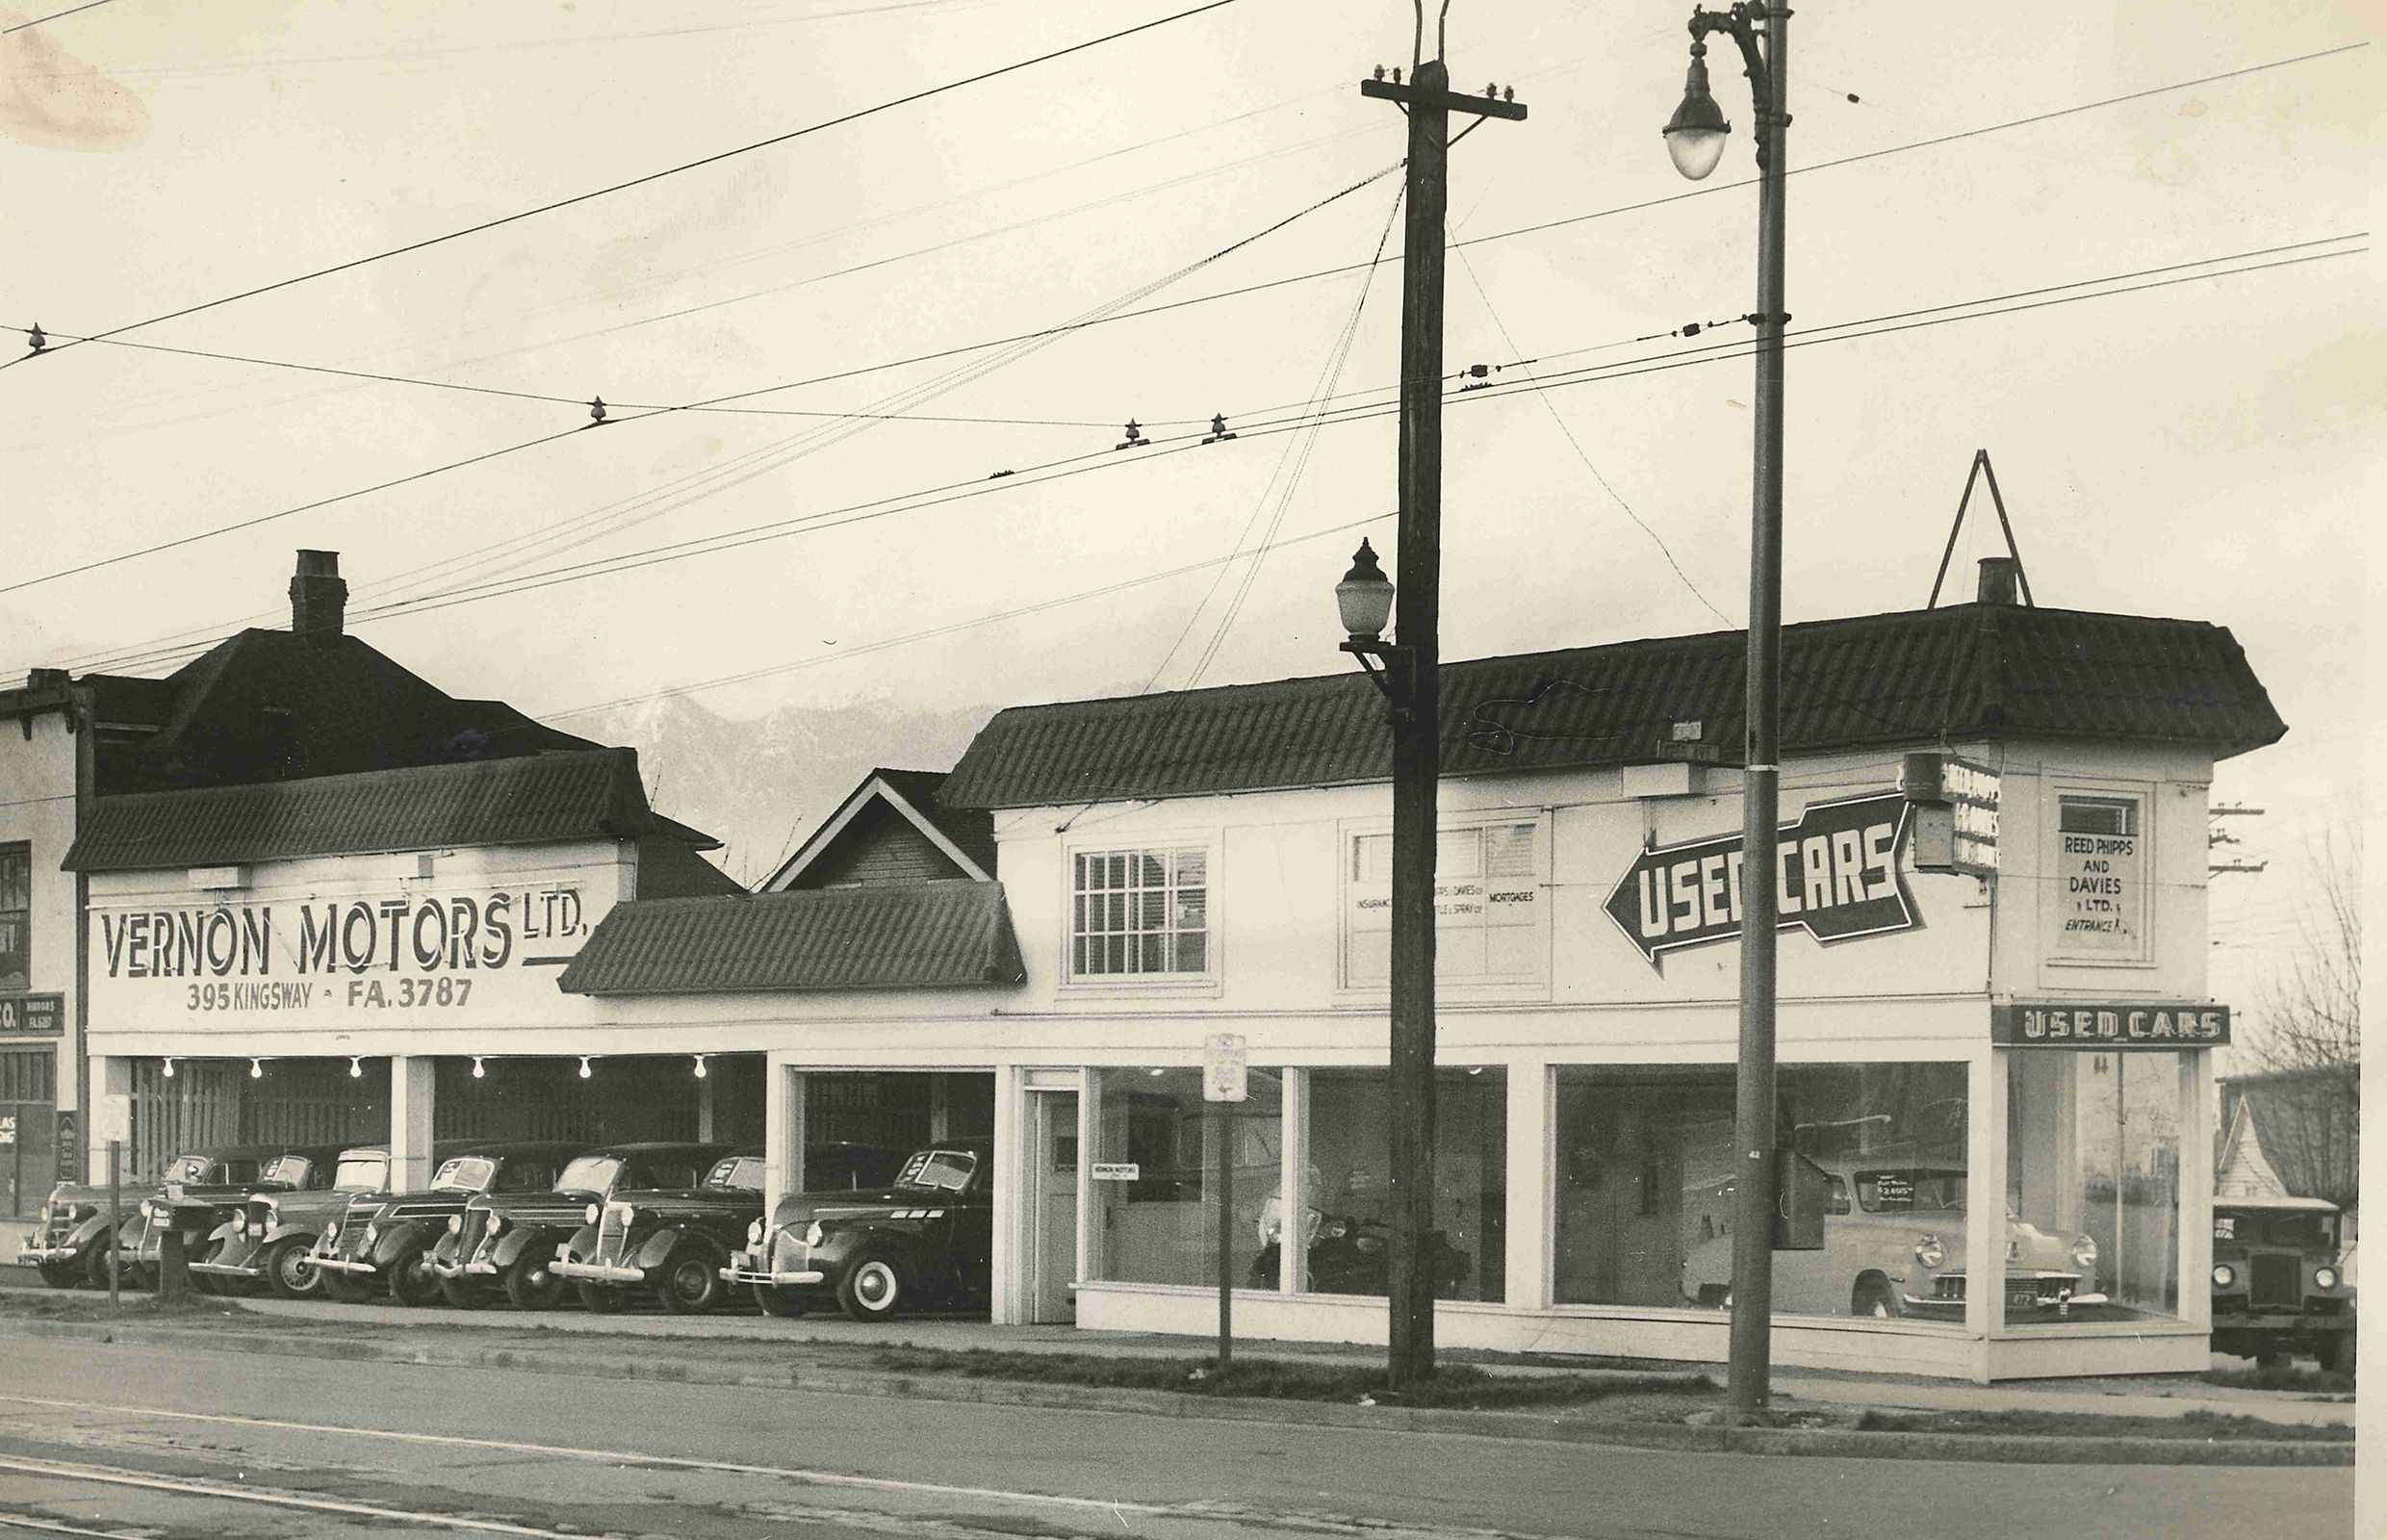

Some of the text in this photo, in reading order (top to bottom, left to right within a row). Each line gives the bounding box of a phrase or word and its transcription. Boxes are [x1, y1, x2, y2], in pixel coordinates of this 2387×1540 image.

[2065, 836, 2133, 856] REED PHIPPS
[1777, 822, 1897, 915] CARS
[2083, 860, 2110, 873] AND
[2070, 876, 2122, 895] DAVIES
[1356, 898, 1392, 910] INSURANC
[1489, 891, 1534, 904] MORTGAGES
[2086, 899, 2114, 911] LTD.
[101, 907, 271, 979] VERNON
[297, 891, 512, 975] MOTORS
[2065, 918, 2113, 933] ENTRANCE
[187, 977, 474, 1012] 395 KINGSWAY FA. 3787
[2024, 1010, 2221, 1039] USED CARS
